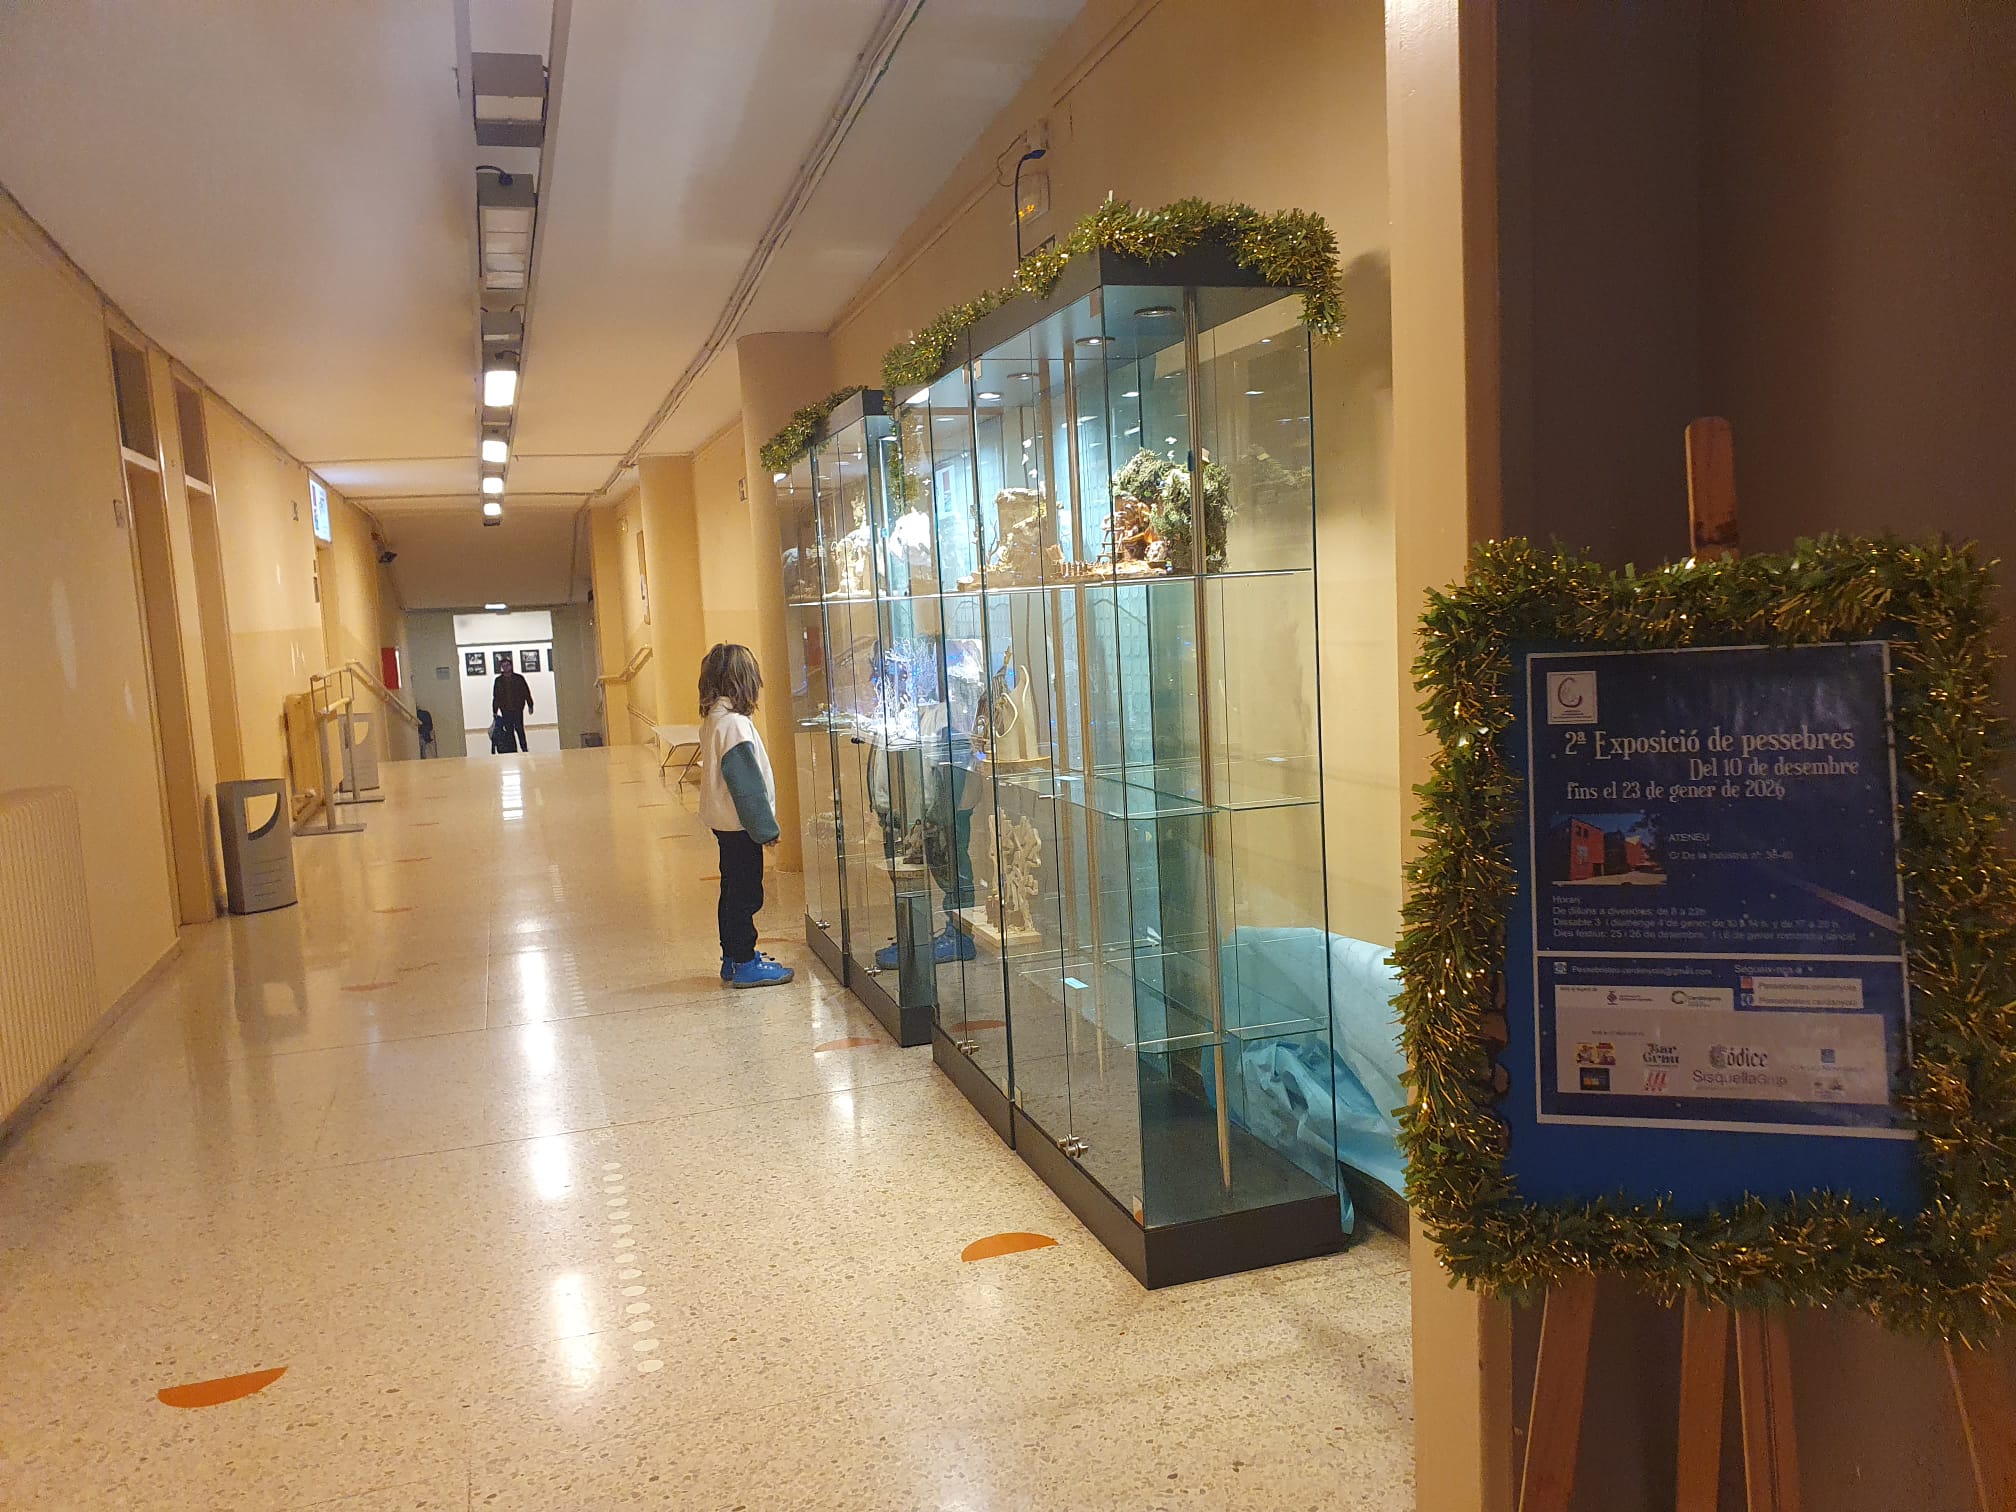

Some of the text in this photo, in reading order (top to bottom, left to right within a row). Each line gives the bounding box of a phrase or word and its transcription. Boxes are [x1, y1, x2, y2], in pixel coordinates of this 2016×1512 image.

[1593, 730, 1700, 761] Exposició
[1707, 726, 1734, 752] de
[1741, 724, 1856, 758] pessebres
[1689, 756, 1860, 782] Del 10 de desembre
[1602, 781, 1617, 799] el
[1621, 782, 1641, 799] 23
[1645, 781, 1664, 800] de
[1669, 784, 1716, 803] gener
[1721, 780, 1741, 799] de
[1744, 780, 1786, 801] 2026
